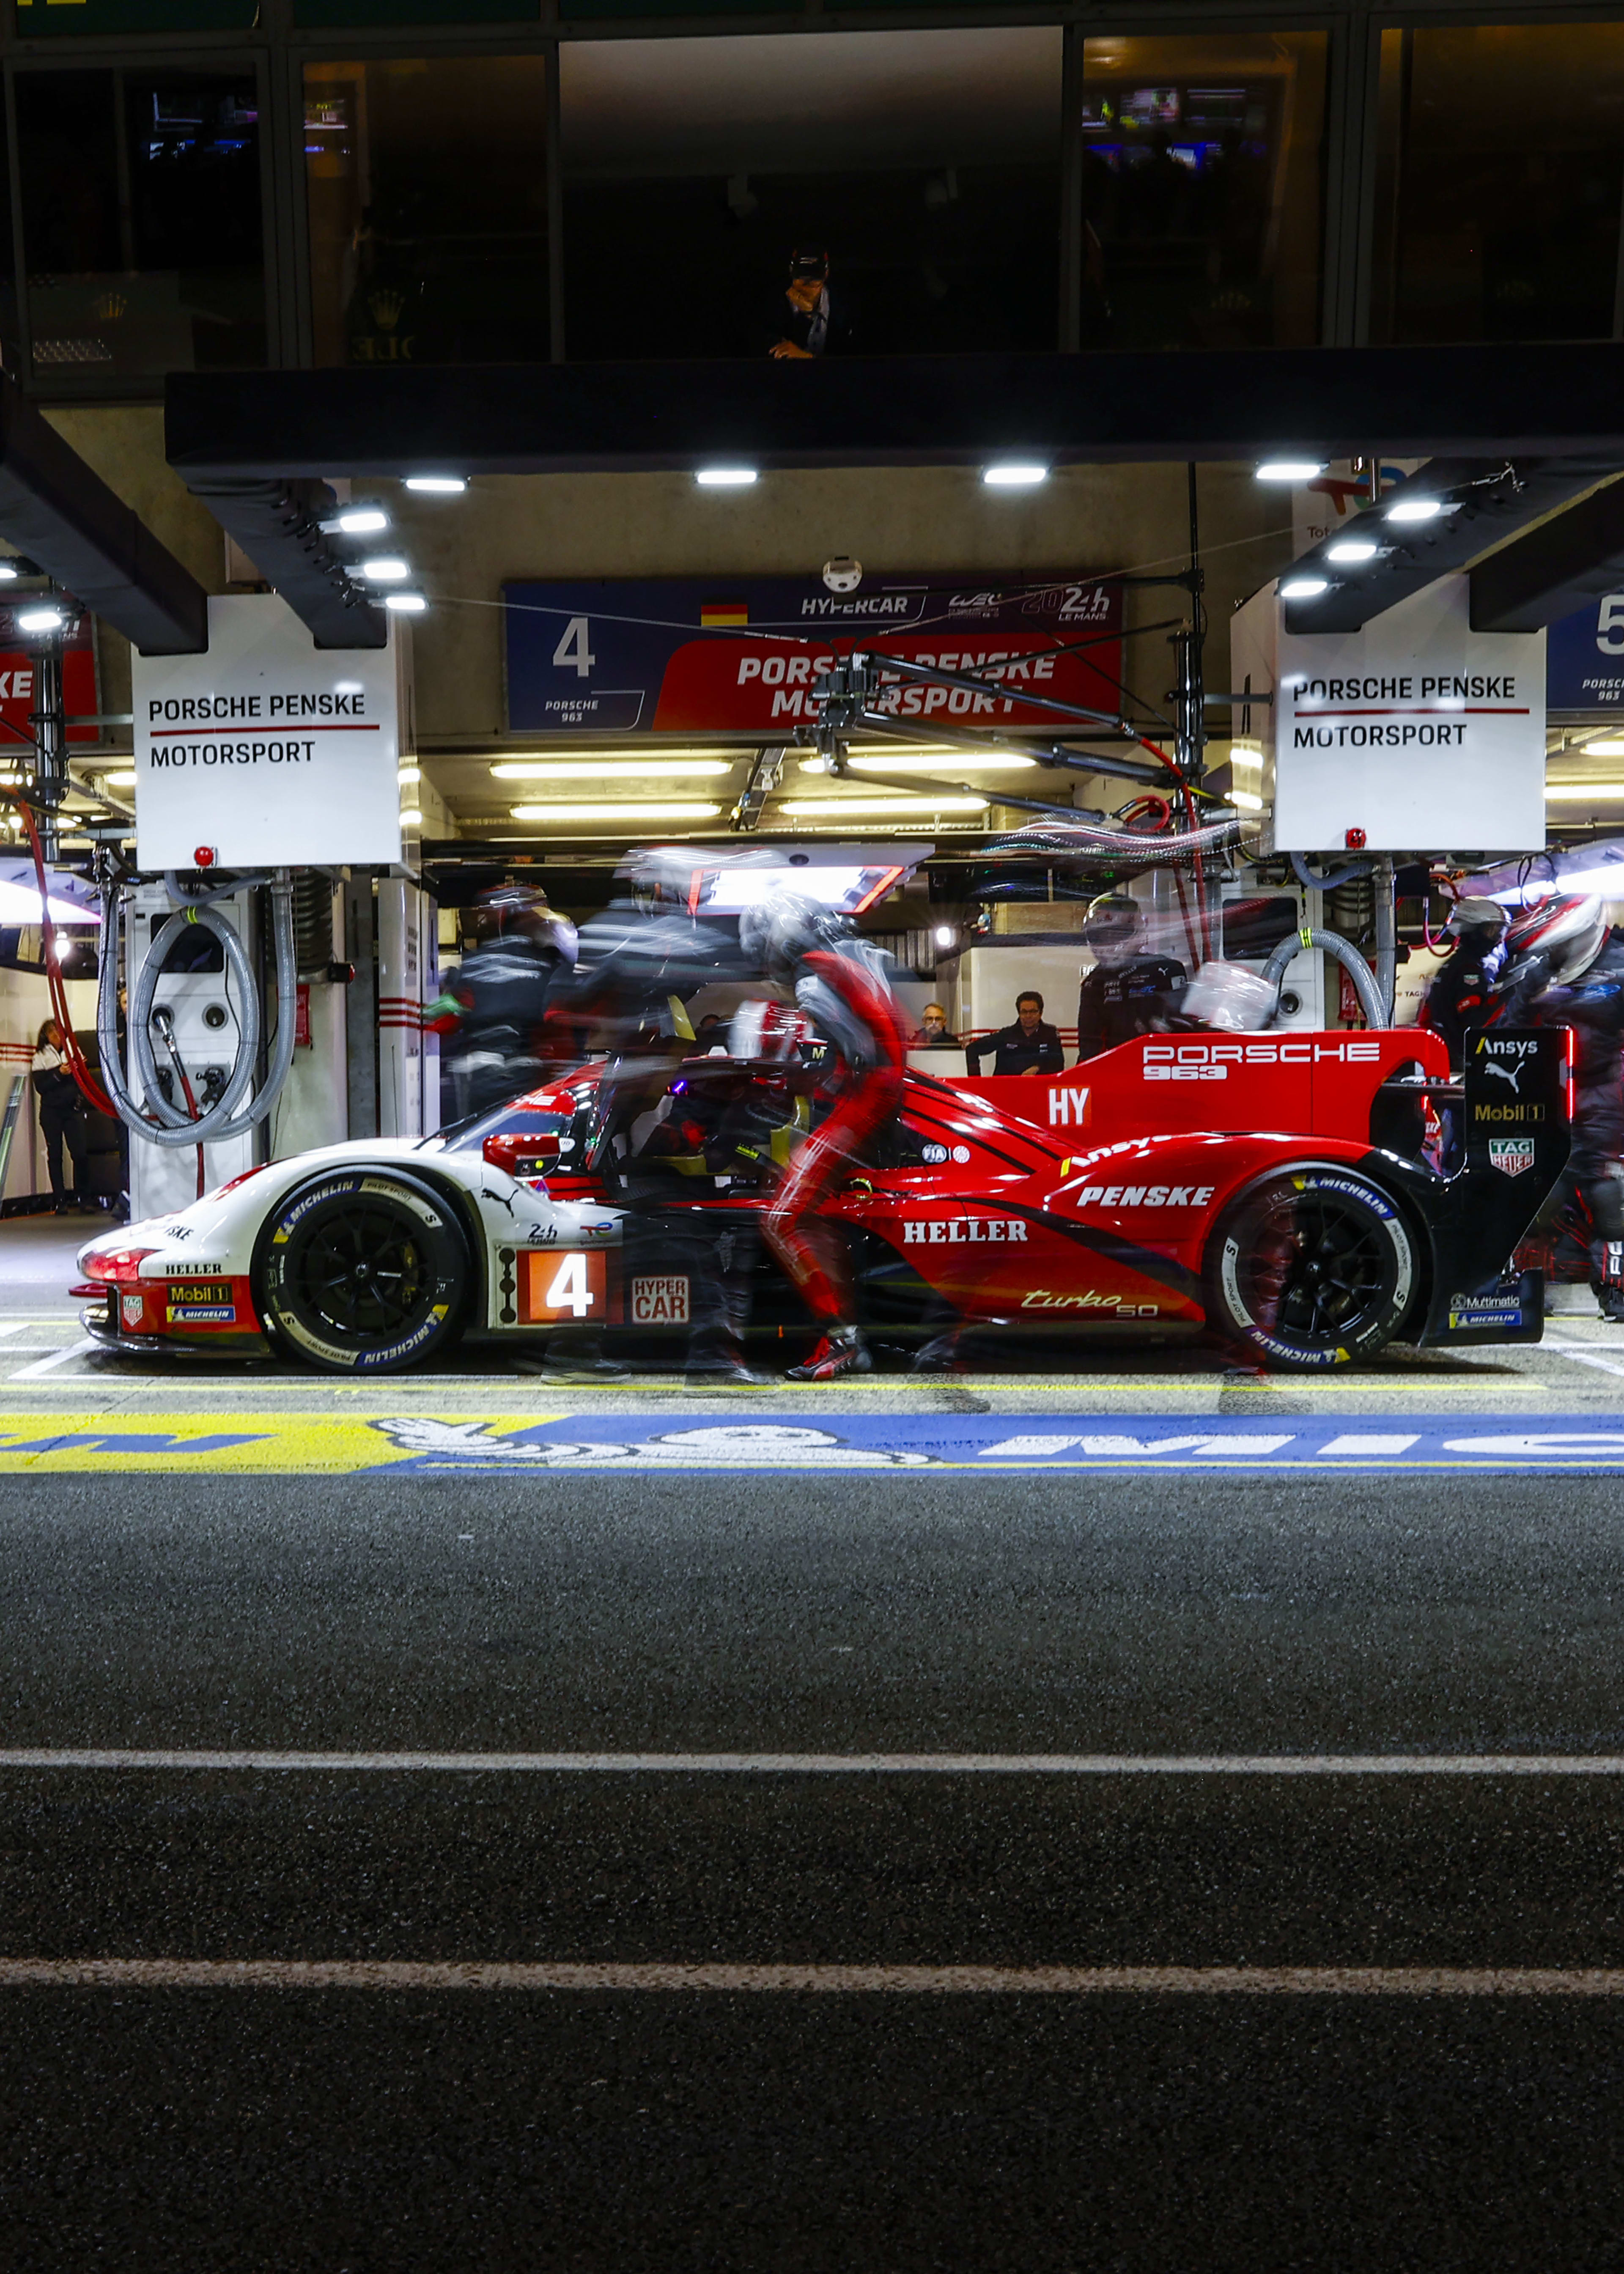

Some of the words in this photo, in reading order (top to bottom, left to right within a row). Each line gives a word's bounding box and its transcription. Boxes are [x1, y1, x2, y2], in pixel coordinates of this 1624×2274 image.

[552, 617, 595, 678] 4
[1294, 677, 1412, 701] PORSCHE
[1421, 676, 1515, 698] PENSKE
[149, 696, 261, 721] PORSCHE
[270, 694, 365, 716] PENSKE
[545, 699, 599, 711] PORSCHE
[562, 712, 582, 722] 963
[1294, 724, 1467, 748] MOTORSPORT
[151, 741, 315, 767] MOTORSPORT
[1143, 1042, 1380, 1064] PORSCHE
[1475, 1036, 1539, 1058] Ansys
[1143, 1064, 1227, 1080] 963
[1048, 1087, 1089, 1126] HY
[1475, 1104, 1525, 1122] Mobil
[1493, 1142, 1530, 1153] TAG
[1492, 1155, 1533, 1172] HEUER
[290, 1180, 354, 1222] MICHELIN
[1077, 1185, 1215, 1207] PENSKE
[1319, 1177, 1389, 1215] MICHELIN
[903, 1221, 1028, 1243] HELLER
[166, 1264, 222, 1275] HELLER
[171, 1286, 211, 1302] Mobil
[546, 1253, 594, 1317] 4
[635, 1278, 685, 1295] HYPER
[635, 1296, 685, 1321] CAR
[1021, 1289, 1122, 1308] turbo
[1467, 1295, 1520, 1308] Multimatic
[185, 1310, 229, 1318] MICHELIN
[1116, 1304, 1158, 1318] 50
[1470, 1314, 1515, 1323] MICHELIN
[364, 1327, 431, 1364] MICHELIN
[1250, 1330, 1322, 1364] MICHELIN
